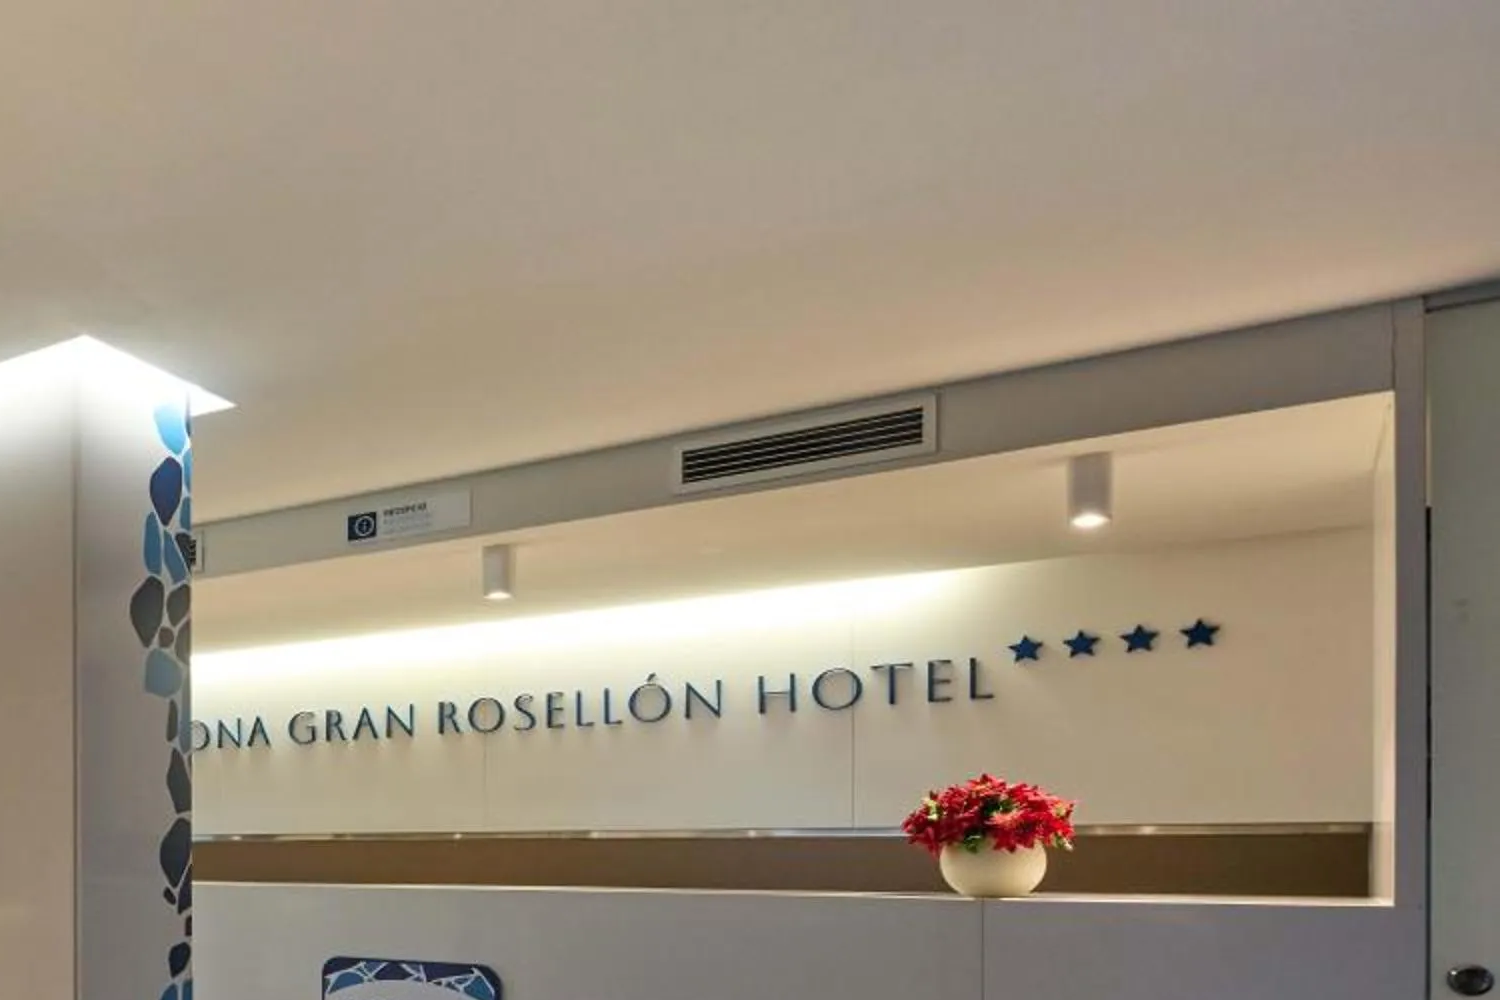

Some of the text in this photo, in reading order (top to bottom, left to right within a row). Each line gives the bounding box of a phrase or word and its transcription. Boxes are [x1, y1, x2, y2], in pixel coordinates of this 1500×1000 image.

[288, 702, 416, 747] GRAN
[436, 672, 724, 736] ROSELLÓN
[757, 657, 996, 716] HOTEL
